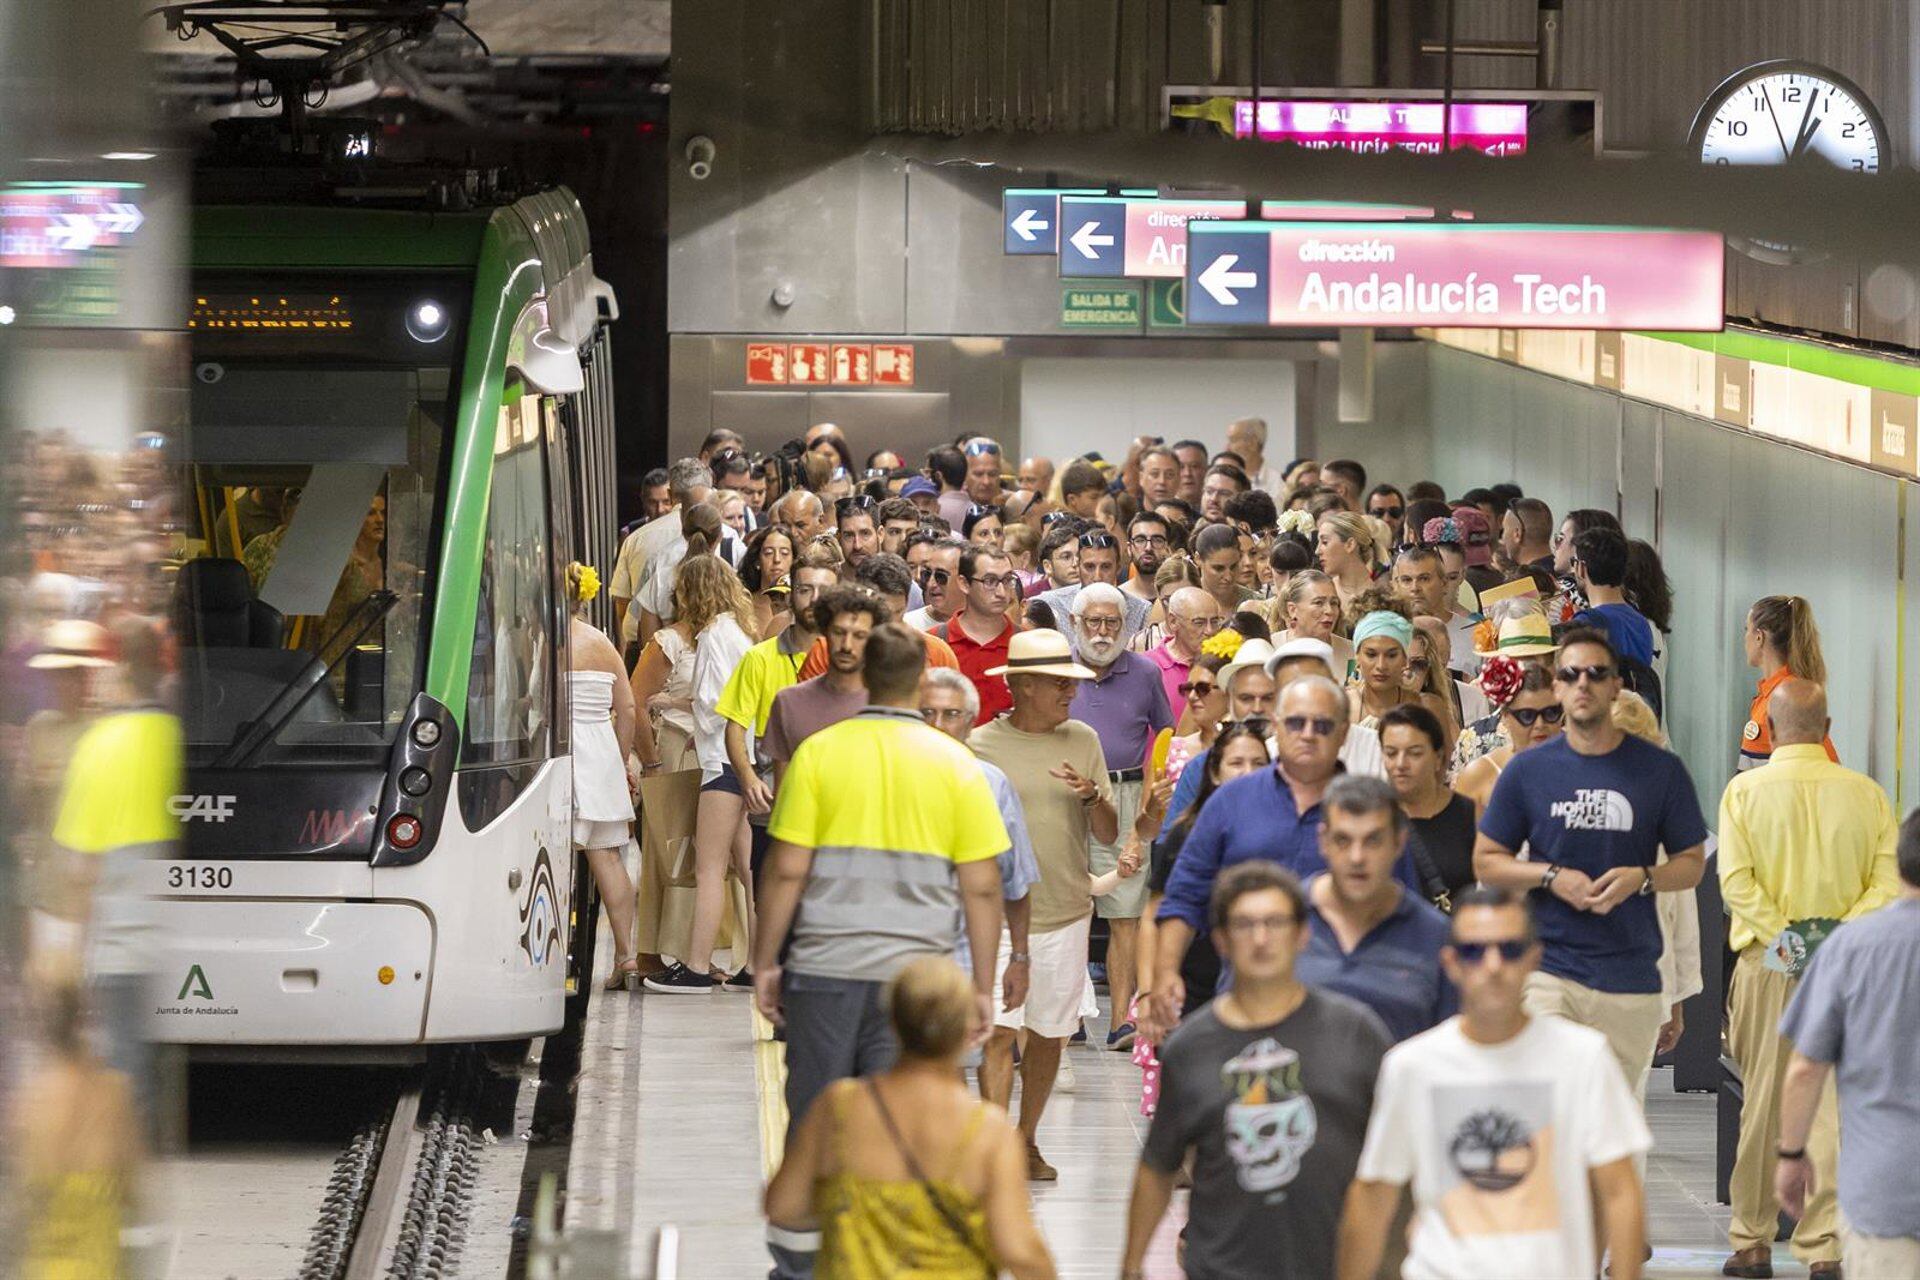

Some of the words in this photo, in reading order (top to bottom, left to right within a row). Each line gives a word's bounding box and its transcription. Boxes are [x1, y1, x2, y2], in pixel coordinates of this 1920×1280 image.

[1783, 87, 1801, 103] 12
[1755, 97, 1765, 112] 11
[1824, 98, 1829, 113] 1
[1728, 120, 1748, 136] 10
[1842, 123, 1856, 138] 2
[1297, 137, 1390, 155] NDUCÍA
[1147, 210, 1220, 228] direc
[1299, 239, 1395, 263] dirección
[1298, 271, 1499, 314] Andalucía
[1512, 273, 1606, 315] Tech
[1574, 789, 1608, 802] THE
[166, 795, 237, 823] CAF
[1550, 801, 1608, 818] NORTH
[1564, 815, 1608, 830] FACE
[168, 865, 233, 889] 3130
[155, 1006, 181, 1016] Junta
[182, 1005, 194, 1016] de
[195, 1004, 239, 1016] Andalucía
